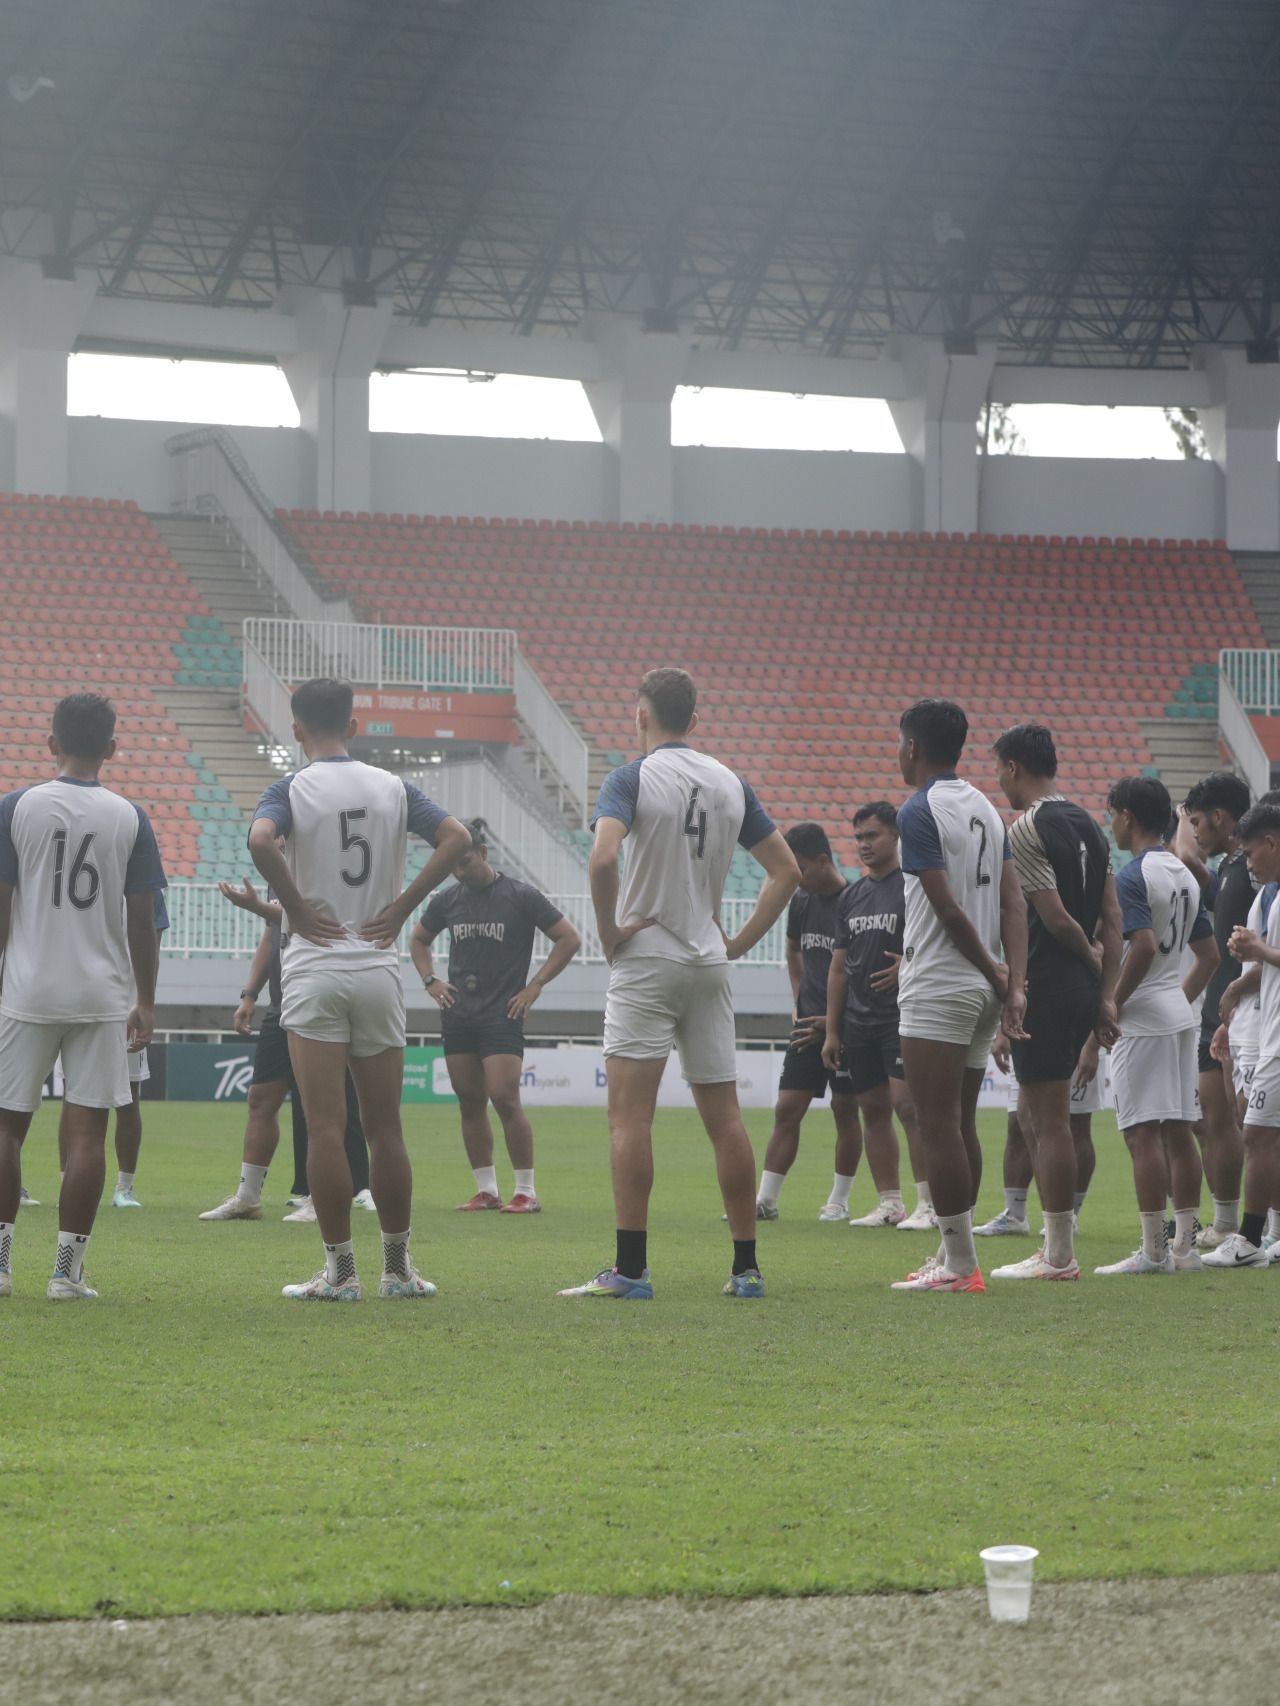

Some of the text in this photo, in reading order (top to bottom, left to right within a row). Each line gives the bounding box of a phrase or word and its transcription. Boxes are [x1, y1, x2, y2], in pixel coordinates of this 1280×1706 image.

[367, 723, 392, 734] EXIT
[378, 695, 416, 711] TRIBUNE
[418, 697, 442, 712] GATE
[338, 806, 373, 888] 5
[683, 786, 709, 861] 4
[51, 828, 100, 911] 16
[969, 815, 991, 888] 2
[1079, 840, 1088, 893] 1
[848, 913, 898, 940] PERSIKAD
[1249, 1089, 1266, 1110] 28
